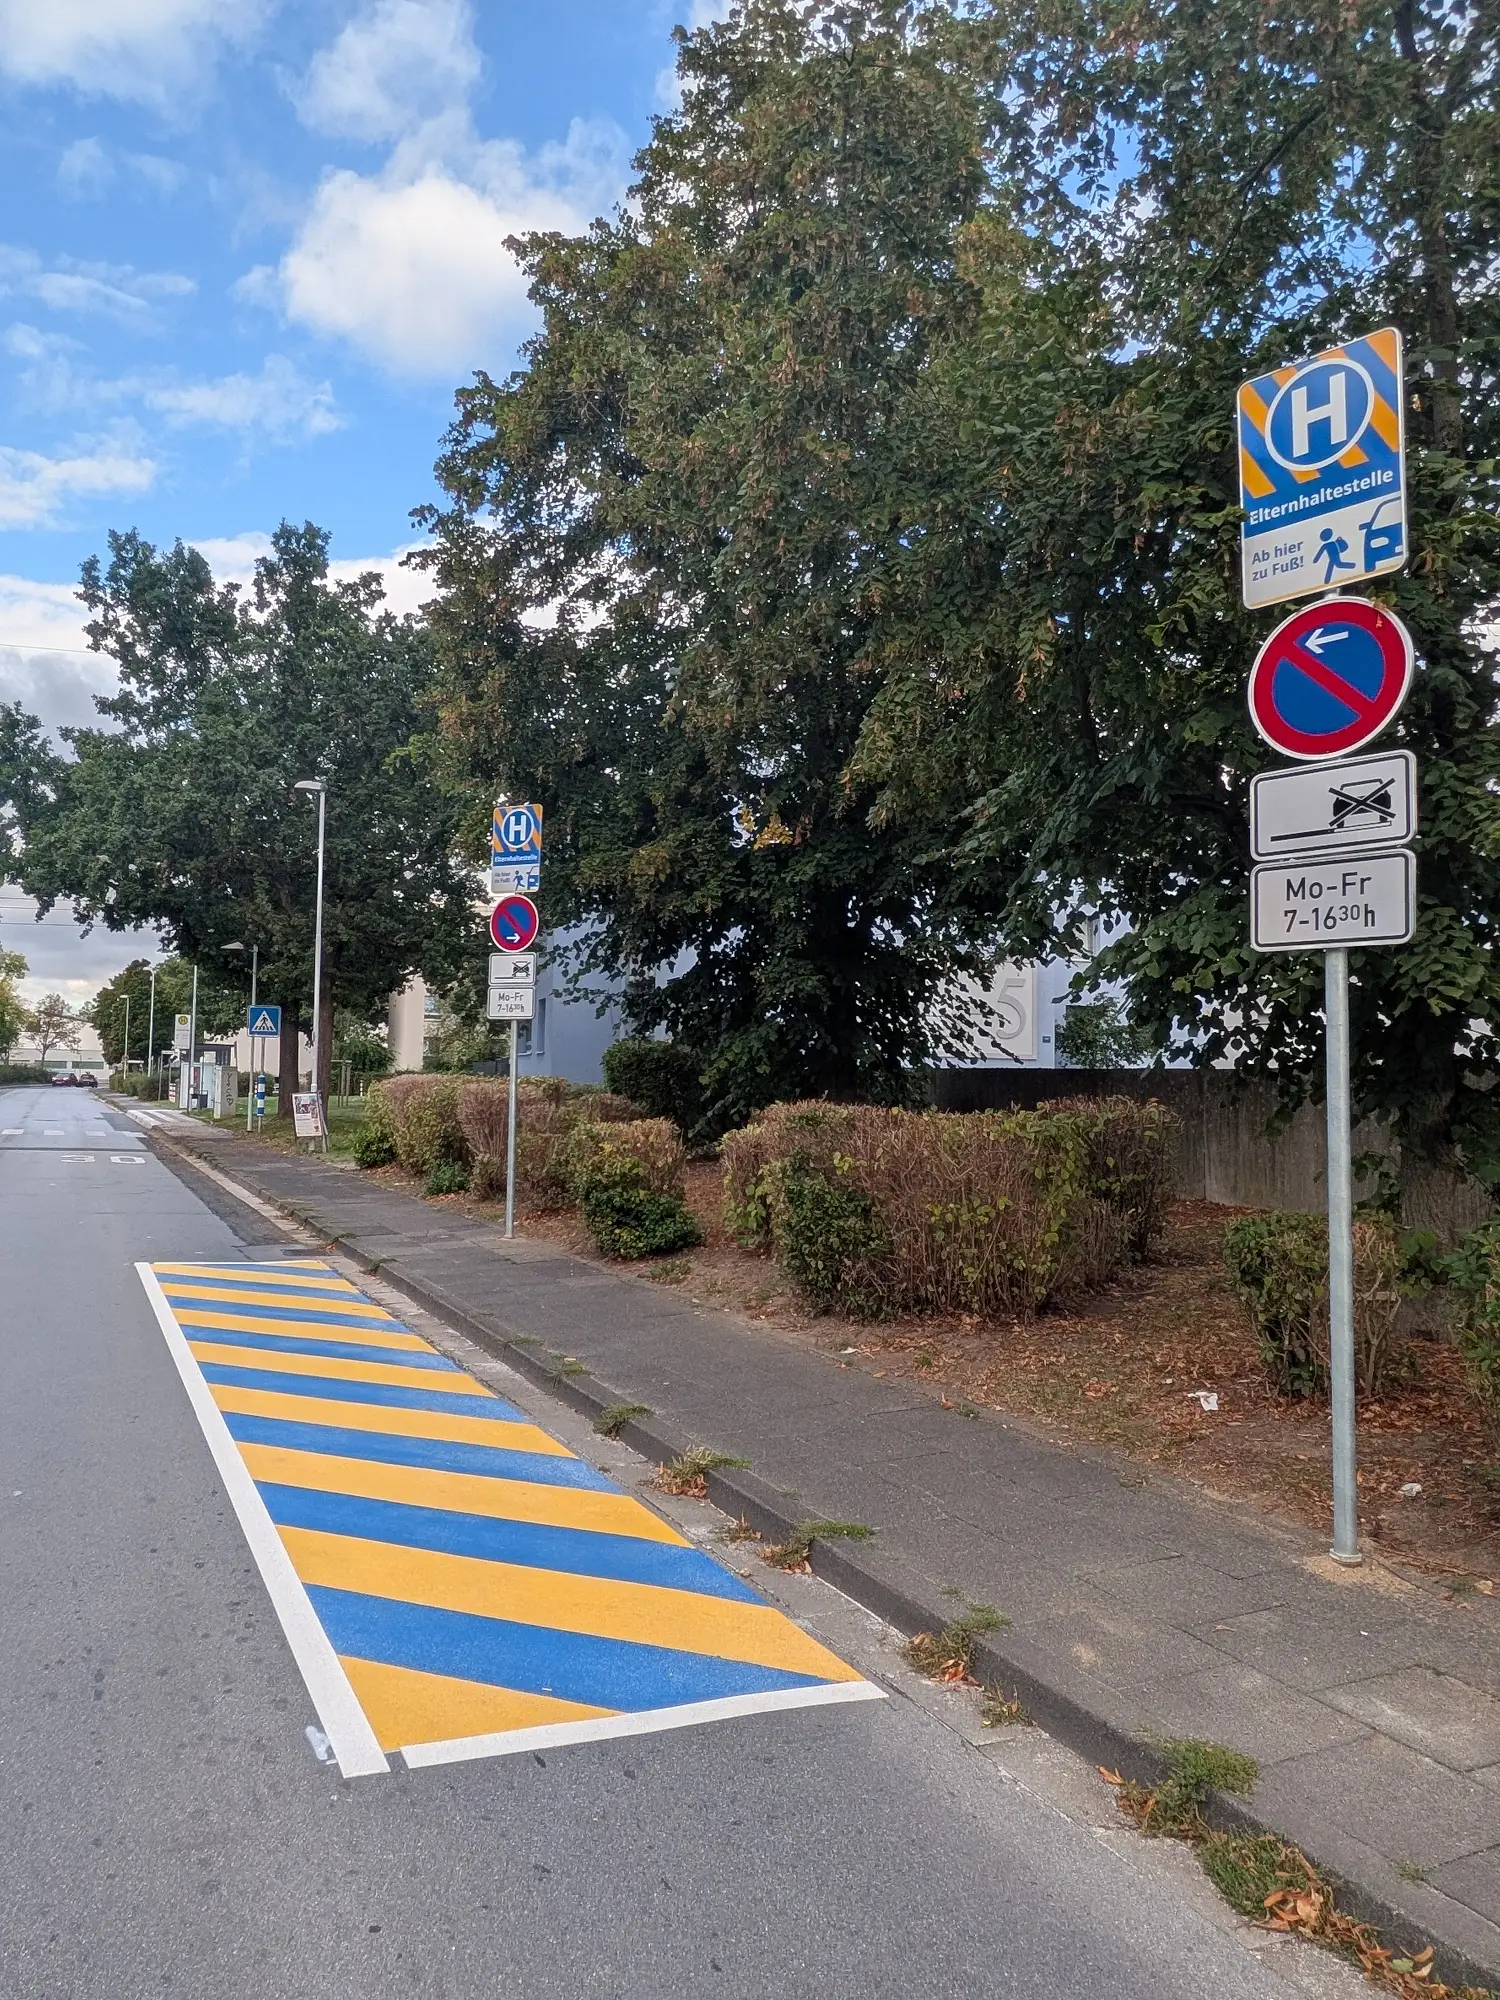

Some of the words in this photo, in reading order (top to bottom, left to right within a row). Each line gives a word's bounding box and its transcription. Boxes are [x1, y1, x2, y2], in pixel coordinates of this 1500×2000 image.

[1291, 371, 1347, 458] H
[1249, 469, 1394, 526] Elternhaltestelle
[1251, 549, 1270, 566] Ab
[1274, 541, 1304, 559] hier
[1252, 567, 1268, 582] zu
[1272, 555, 1304, 576] Fuß!
[508, 815, 527, 842] H
[1285, 871, 1373, 901] Mo-Fr
[498, 991, 525, 1002] Mo-Fr
[996, 977, 1027, 1040] 5
